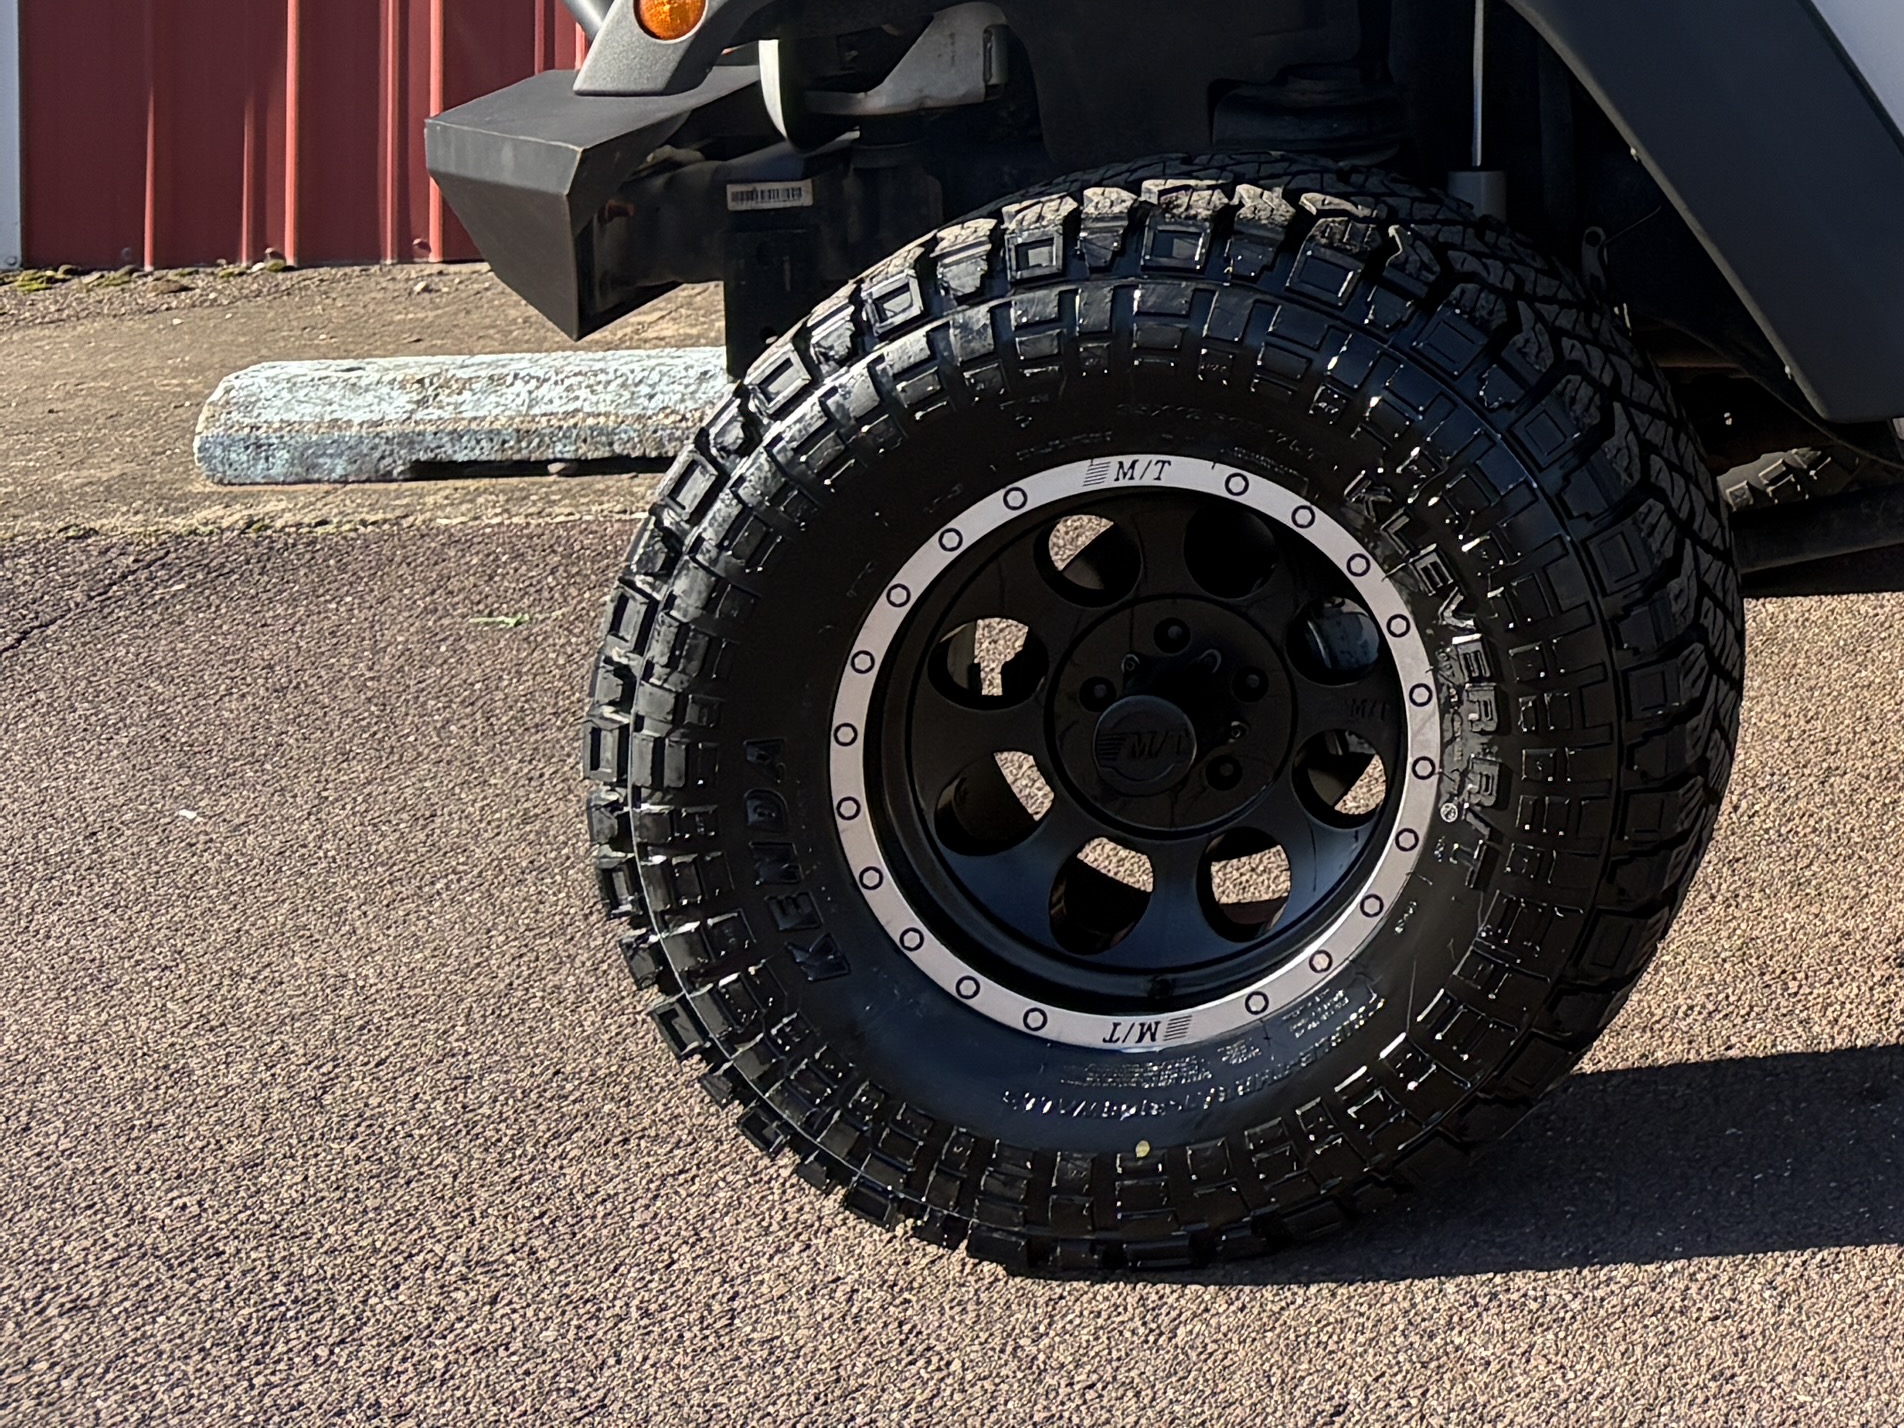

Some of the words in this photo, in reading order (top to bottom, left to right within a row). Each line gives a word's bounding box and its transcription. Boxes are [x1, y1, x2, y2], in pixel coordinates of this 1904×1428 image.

[1114, 460, 1171, 482] M/T
[1344, 470, 1498, 735] KLEVER
[744, 738, 850, 982] KENDA
[1102, 1020, 1162, 1044] M/T
